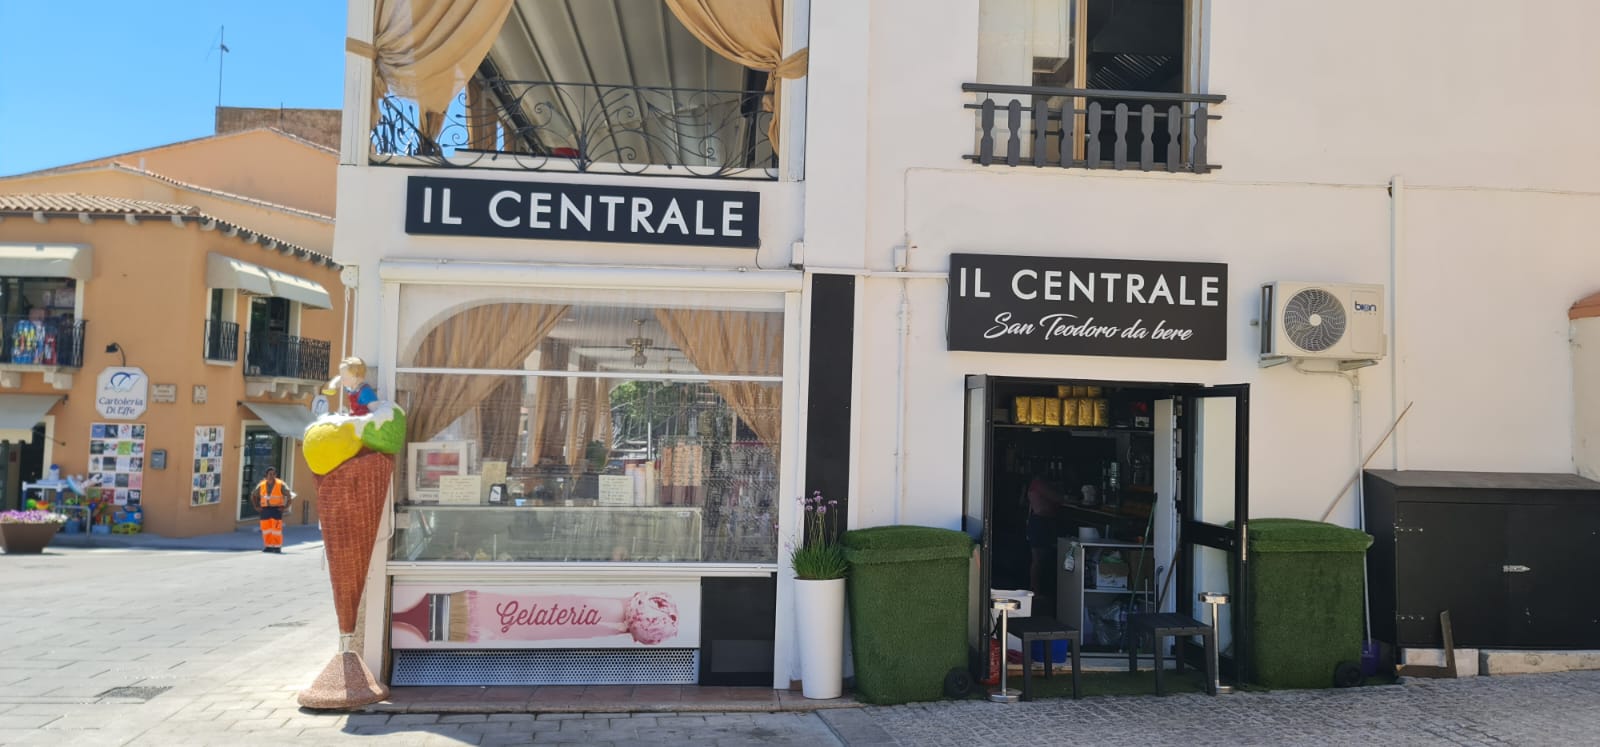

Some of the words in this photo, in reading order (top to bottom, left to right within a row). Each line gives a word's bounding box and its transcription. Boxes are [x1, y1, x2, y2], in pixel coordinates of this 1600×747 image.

[423, 187, 462, 225] IL
[488, 189, 744, 237] CENTRALE
[959, 267, 991, 298] IL
[1011, 269, 1219, 306] CENTRALE
[983, 312, 1035, 339] San
[1039, 313, 1120, 340] Teodoro
[1120, 318, 1149, 340] da
[1151, 319, 1194, 341] bere
[98, 396, 144, 406] Cartoleria
[105, 406, 116, 414] Di
[117, 406, 136, 416] Effe
[496, 600, 601, 633] Gelateria
